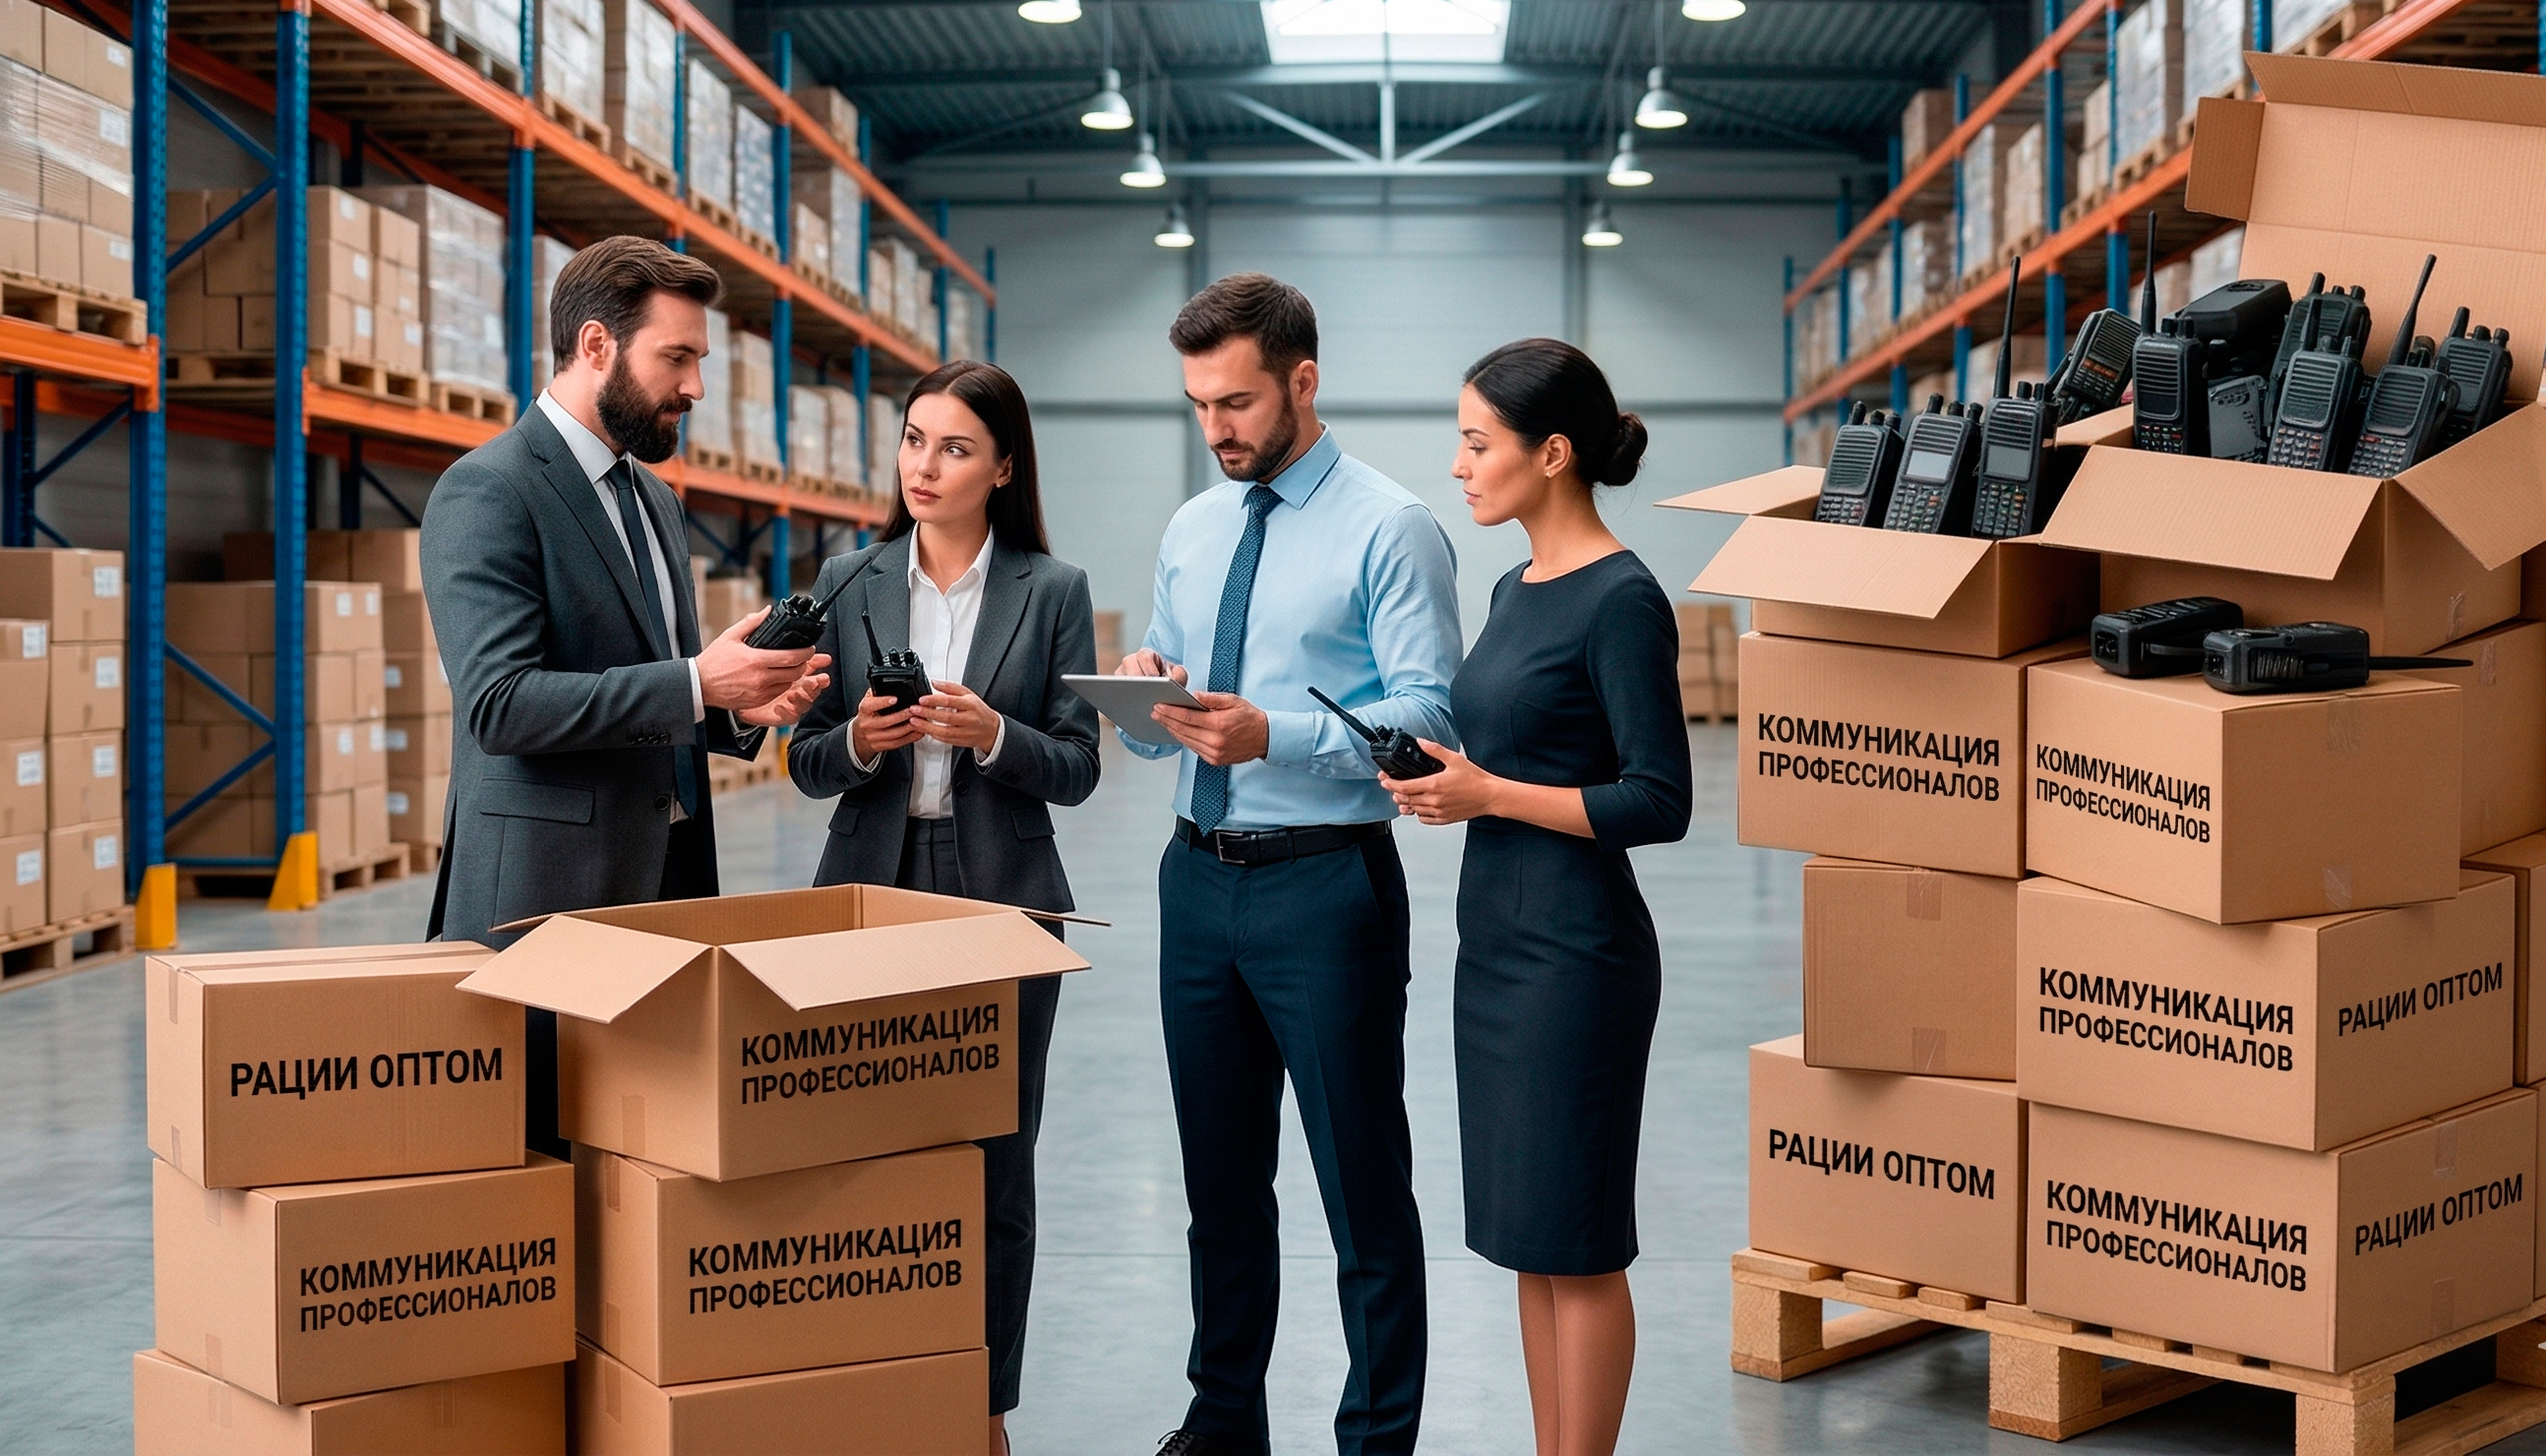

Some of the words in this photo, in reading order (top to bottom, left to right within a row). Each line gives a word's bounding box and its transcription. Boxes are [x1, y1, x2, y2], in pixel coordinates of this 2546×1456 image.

[1758, 712, 2000, 769] КОММУНИКАЦИЯ
[1759, 751, 2000, 802] ПРОФЕССИОНАЛОВ
[2036, 743, 2211, 812] КОММУНИКАЦИЯ
[2035, 777, 2211, 844] ПРОФЕССИОНАЛОВ
[2039, 966, 2293, 1036] КОММУНИКАЦИЯ
[2338, 987, 2416, 1037] РАЦИИ
[2423, 961, 2503, 1011] ОПТОМ
[742, 1002, 1000, 1067] КОММУНИКАЦИЯ
[2039, 1005, 2293, 1072] ПРОФЕССИОНАЛОВ
[230, 1056, 358, 1101] РАЦИИ
[370, 1047, 503, 1089] ОПТОМ
[742, 1043, 1000, 1105] ПРОФЕССИОНАЛОВ
[1769, 1128, 1874, 1178] РАЦИИ
[1883, 1150, 1995, 1200] ОПТОМ
[2046, 1180, 2307, 1255] КОММУНИКАЦИЯ
[2355, 1202, 2435, 1256] РАЦИИ
[2442, 1173, 2523, 1226] ОПТОМ
[300, 1237, 556, 1297] КОММУНИКАЦИЯ
[689, 1218, 962, 1278] КОММУНИКАЦИЯ
[2046, 1219, 2307, 1293] ПРОФЕССИОНАЛОВ
[300, 1275, 557, 1333] ПРОФЕССИОНАЛОВ
[690, 1259, 962, 1314] ПРОФЕССИОНАЛОВ
